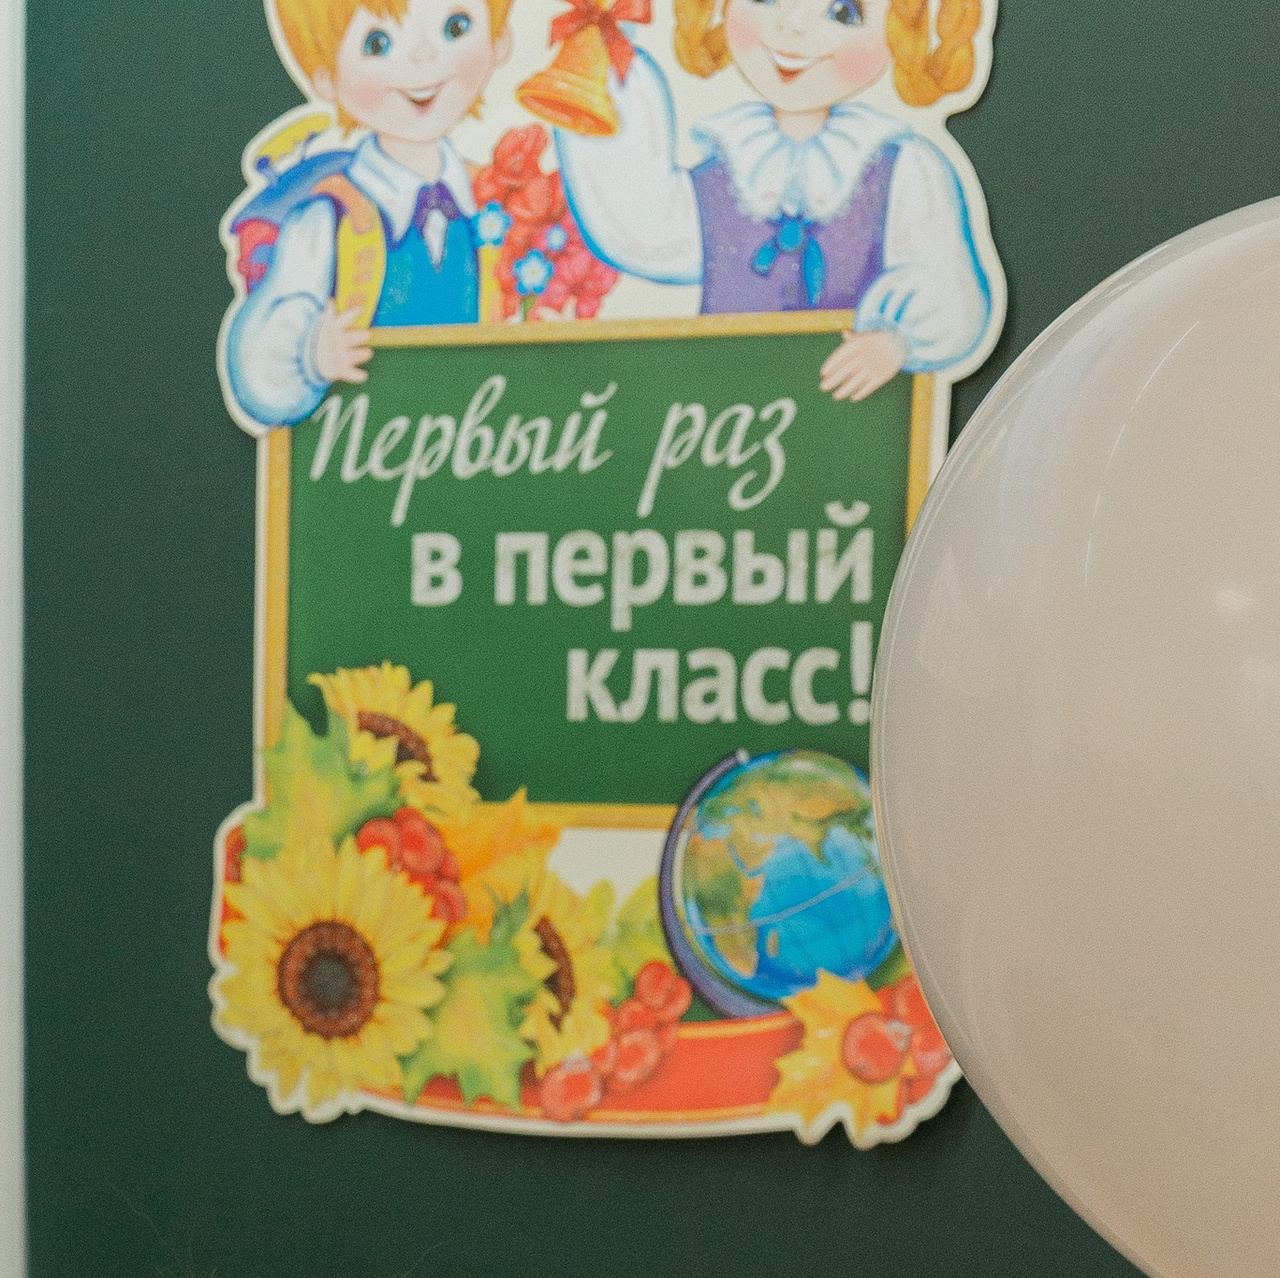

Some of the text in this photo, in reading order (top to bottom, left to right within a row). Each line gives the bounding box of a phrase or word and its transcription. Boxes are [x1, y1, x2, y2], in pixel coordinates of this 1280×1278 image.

[309, 373, 798, 527] Первый раз
[411, 501, 875, 632] в первый
[566, 621, 873, 726] класс!
